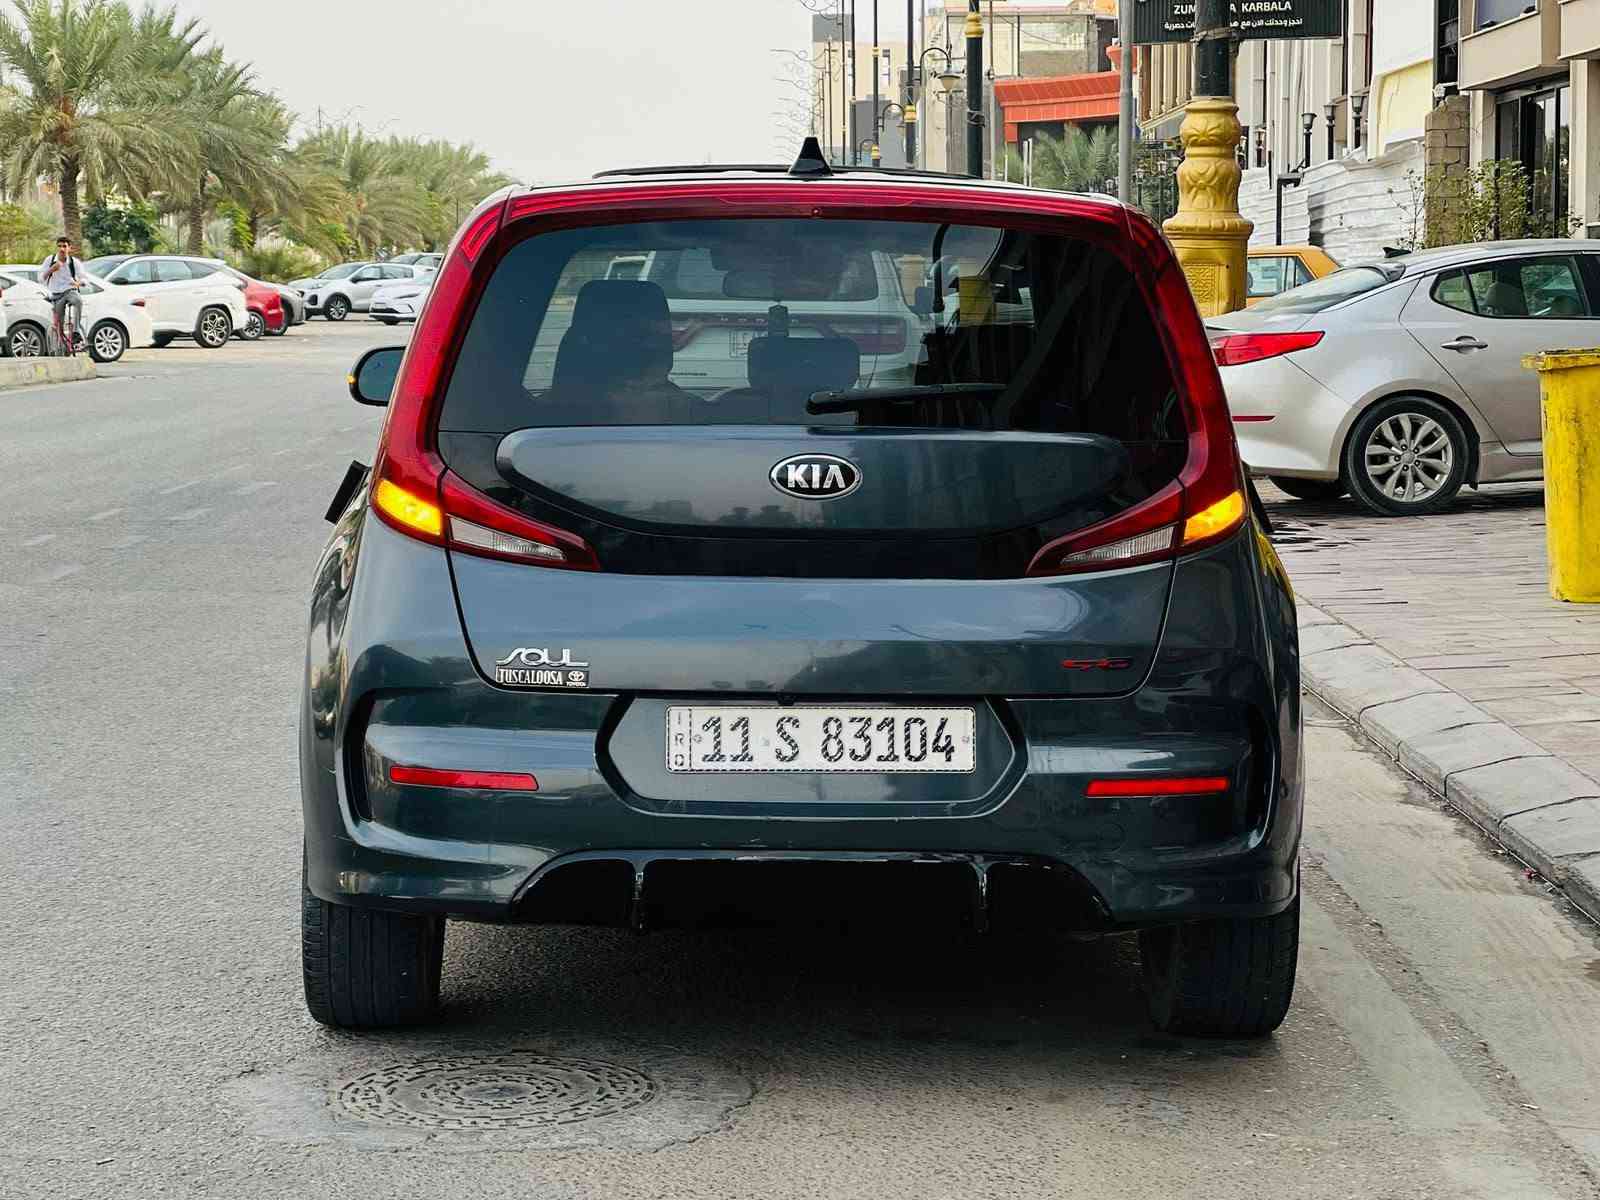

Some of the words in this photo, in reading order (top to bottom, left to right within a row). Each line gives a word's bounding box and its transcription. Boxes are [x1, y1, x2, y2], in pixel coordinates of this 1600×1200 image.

[1241, 1, 1292, 12] KARBALA
[786, 463, 846, 489] KIA
[498, 668, 563, 685] TUSCALOOSA
[702, 716, 753, 762] 11
[775, 716, 800, 762] S
[820, 716, 956, 763] 83104
